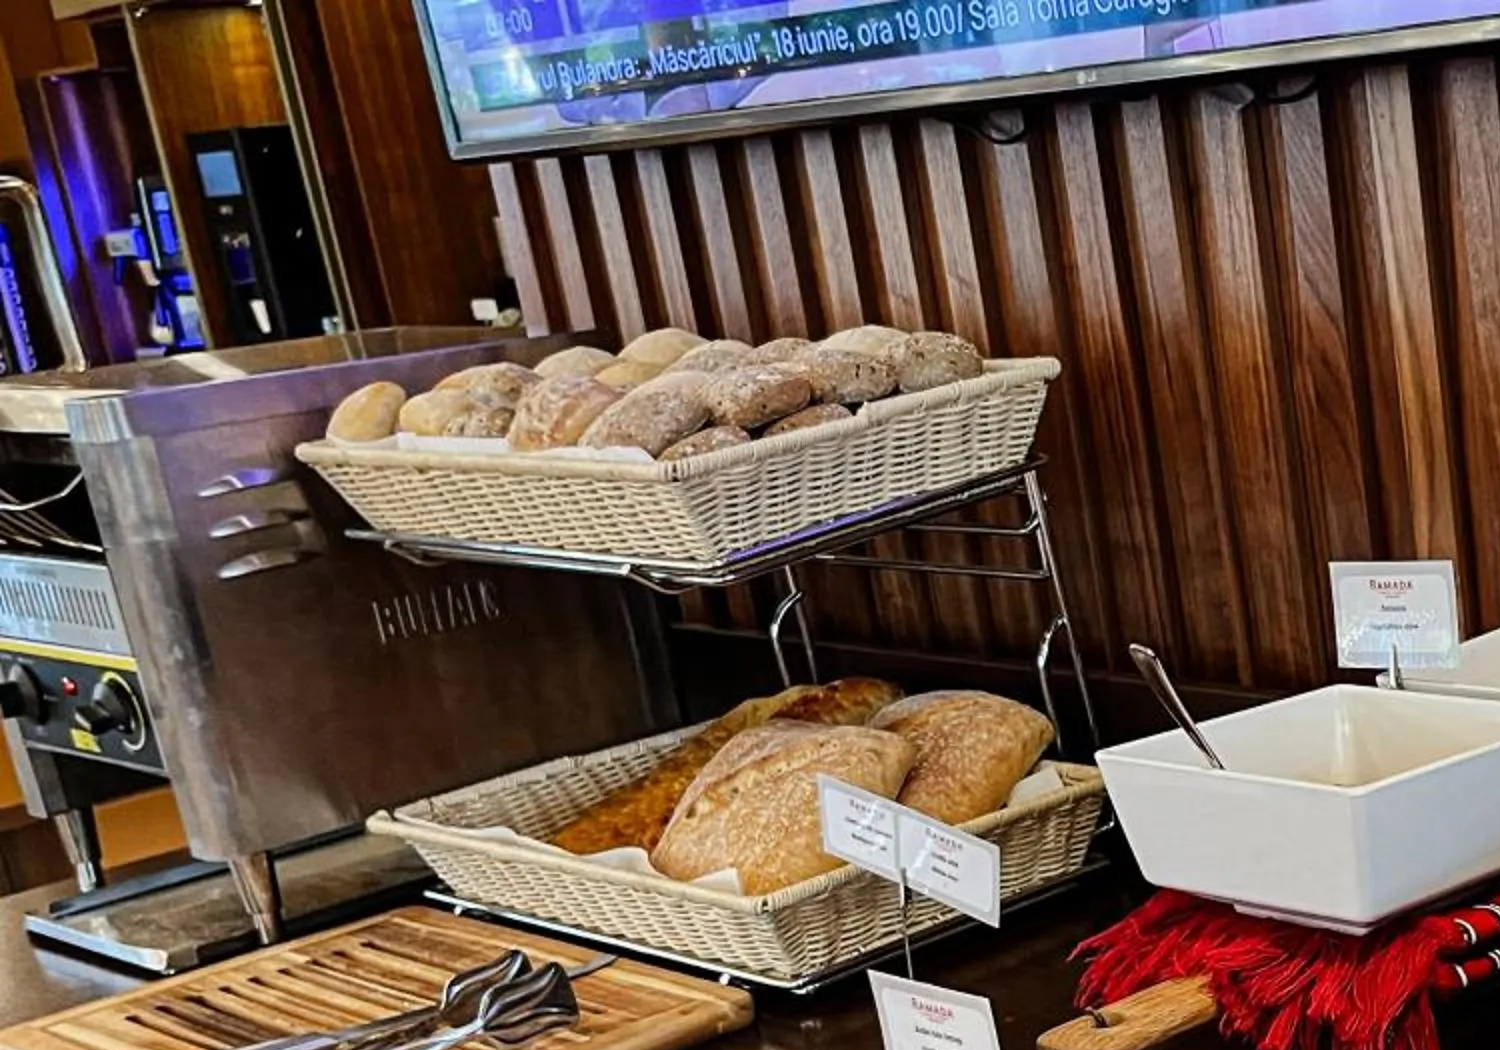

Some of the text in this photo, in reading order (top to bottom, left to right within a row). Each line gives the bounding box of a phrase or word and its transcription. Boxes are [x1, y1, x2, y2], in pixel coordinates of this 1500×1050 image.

[771, 28, 793, 58] 18
[797, 22, 855, 55] iunie,
[857, 19, 894, 47] ora
[968, 0, 1019, 31] Sala
